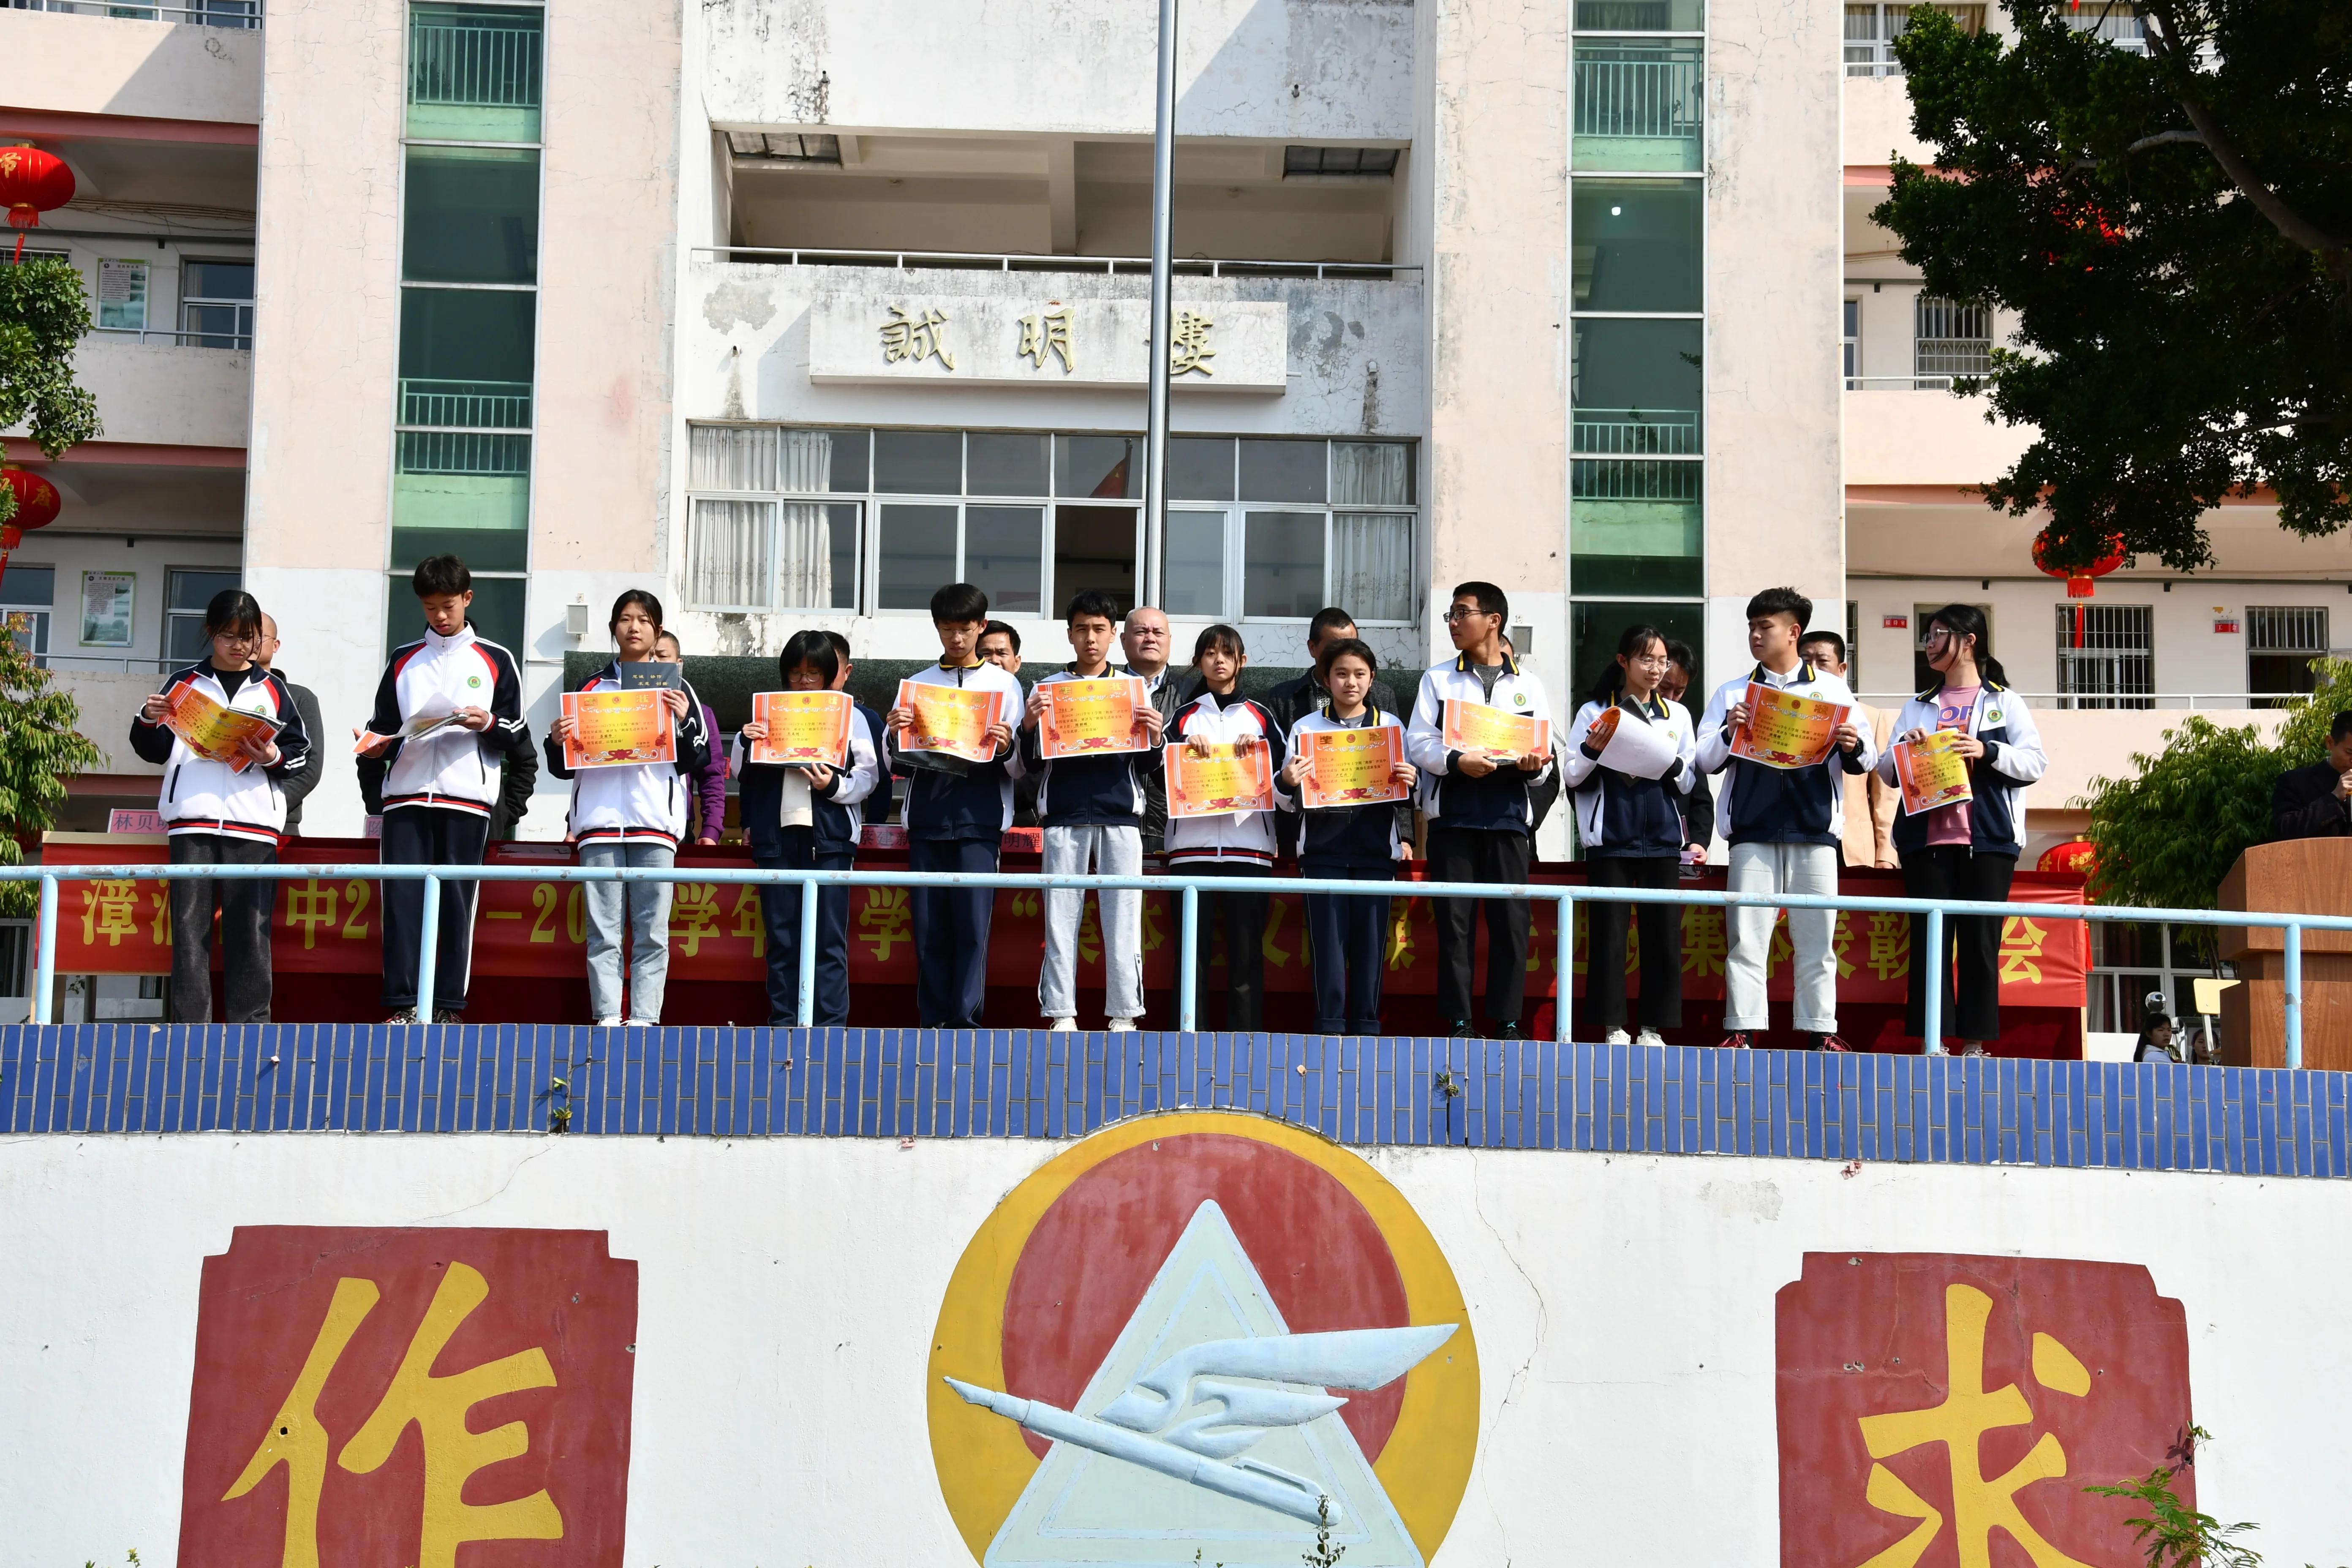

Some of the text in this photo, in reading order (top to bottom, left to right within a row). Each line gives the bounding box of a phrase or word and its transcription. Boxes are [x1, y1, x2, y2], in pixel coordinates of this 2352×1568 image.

[1004, 832, 1041, 848] 明耀
[220, 1260, 564, 1568] 作
[1854, 1282, 2100, 1568] 求
